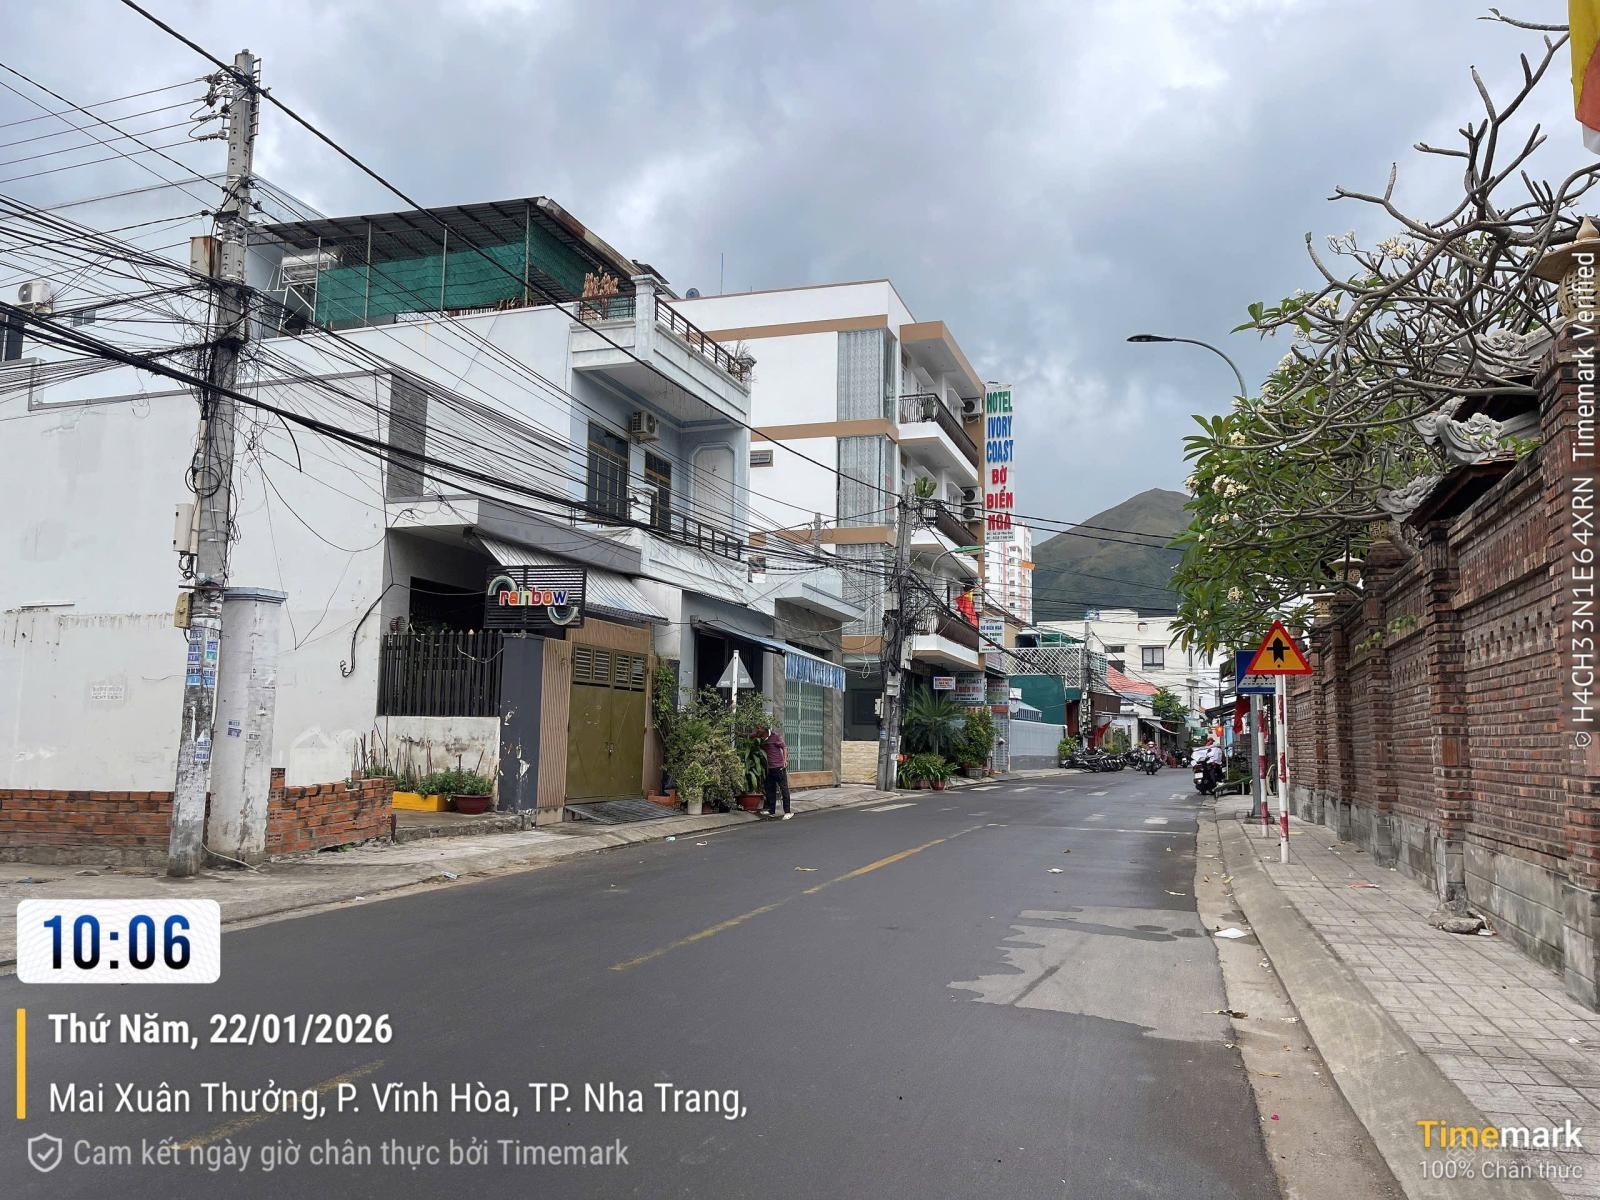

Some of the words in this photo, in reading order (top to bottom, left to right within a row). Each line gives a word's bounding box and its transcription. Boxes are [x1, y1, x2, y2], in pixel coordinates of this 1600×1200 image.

[986, 390, 1014, 414] HOTEL
[987, 415, 1013, 439] IVORY
[986, 439, 1014, 464] COAST
[991, 464, 1008, 485] BỜ
[986, 485, 1014, 510] BIỂN
[499, 584, 569, 606] rainbow
